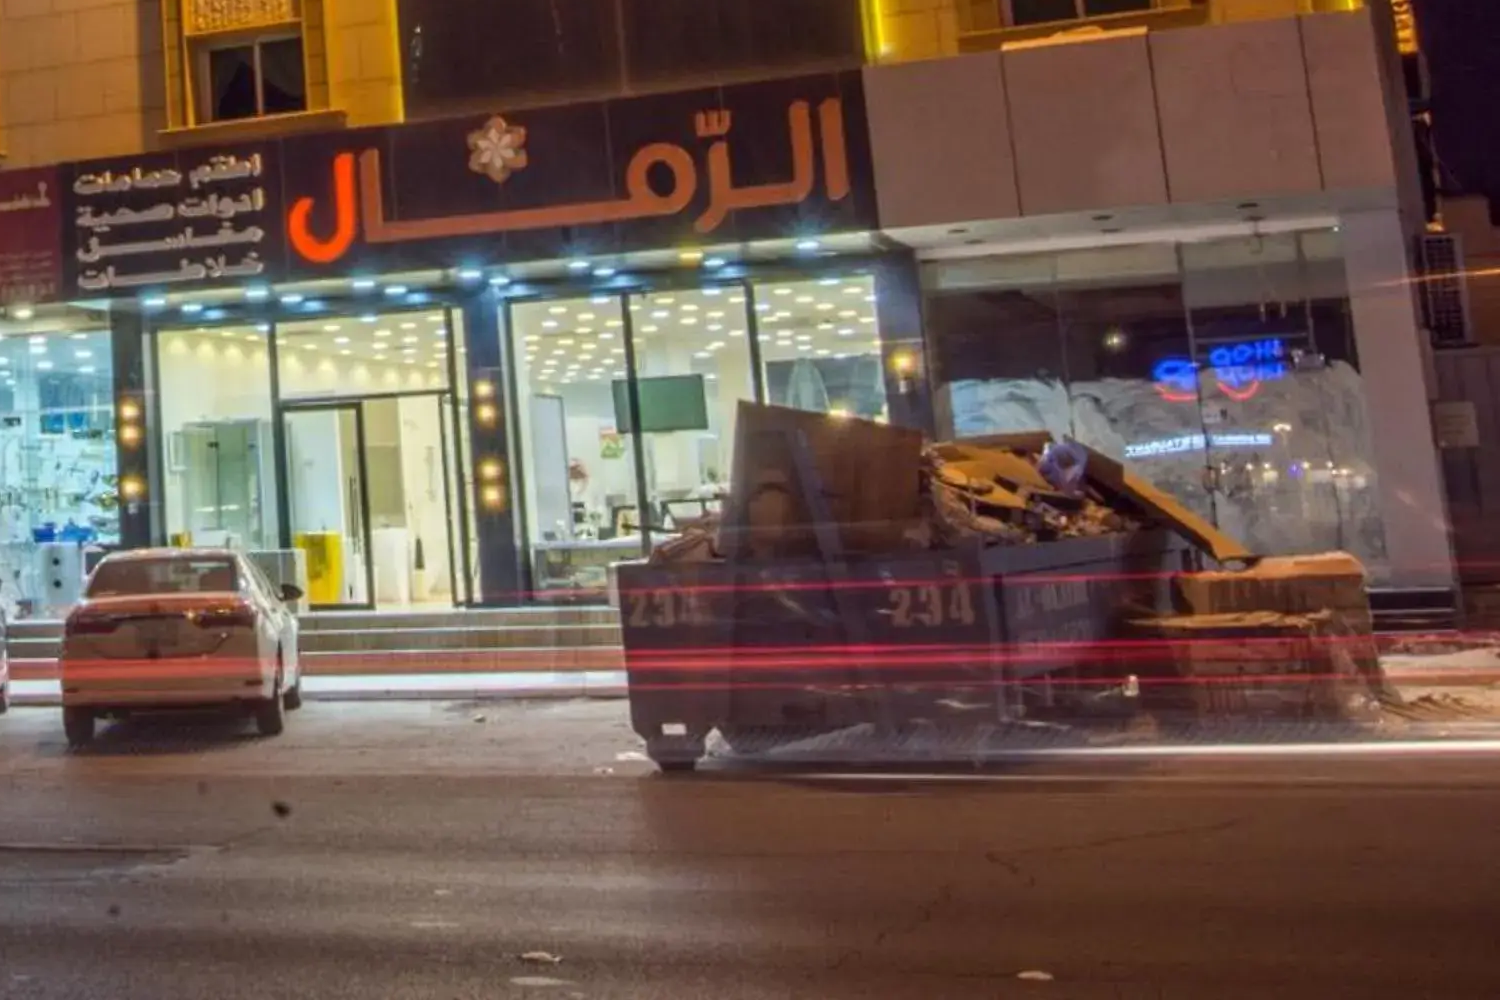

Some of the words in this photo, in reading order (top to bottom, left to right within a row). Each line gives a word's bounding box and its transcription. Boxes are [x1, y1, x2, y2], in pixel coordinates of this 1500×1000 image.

[73, 166, 182, 195] حمامات
[76, 203, 175, 233] صحية
[76, 220, 265, 263] مغاسل
[77, 251, 265, 290] خلاطات
